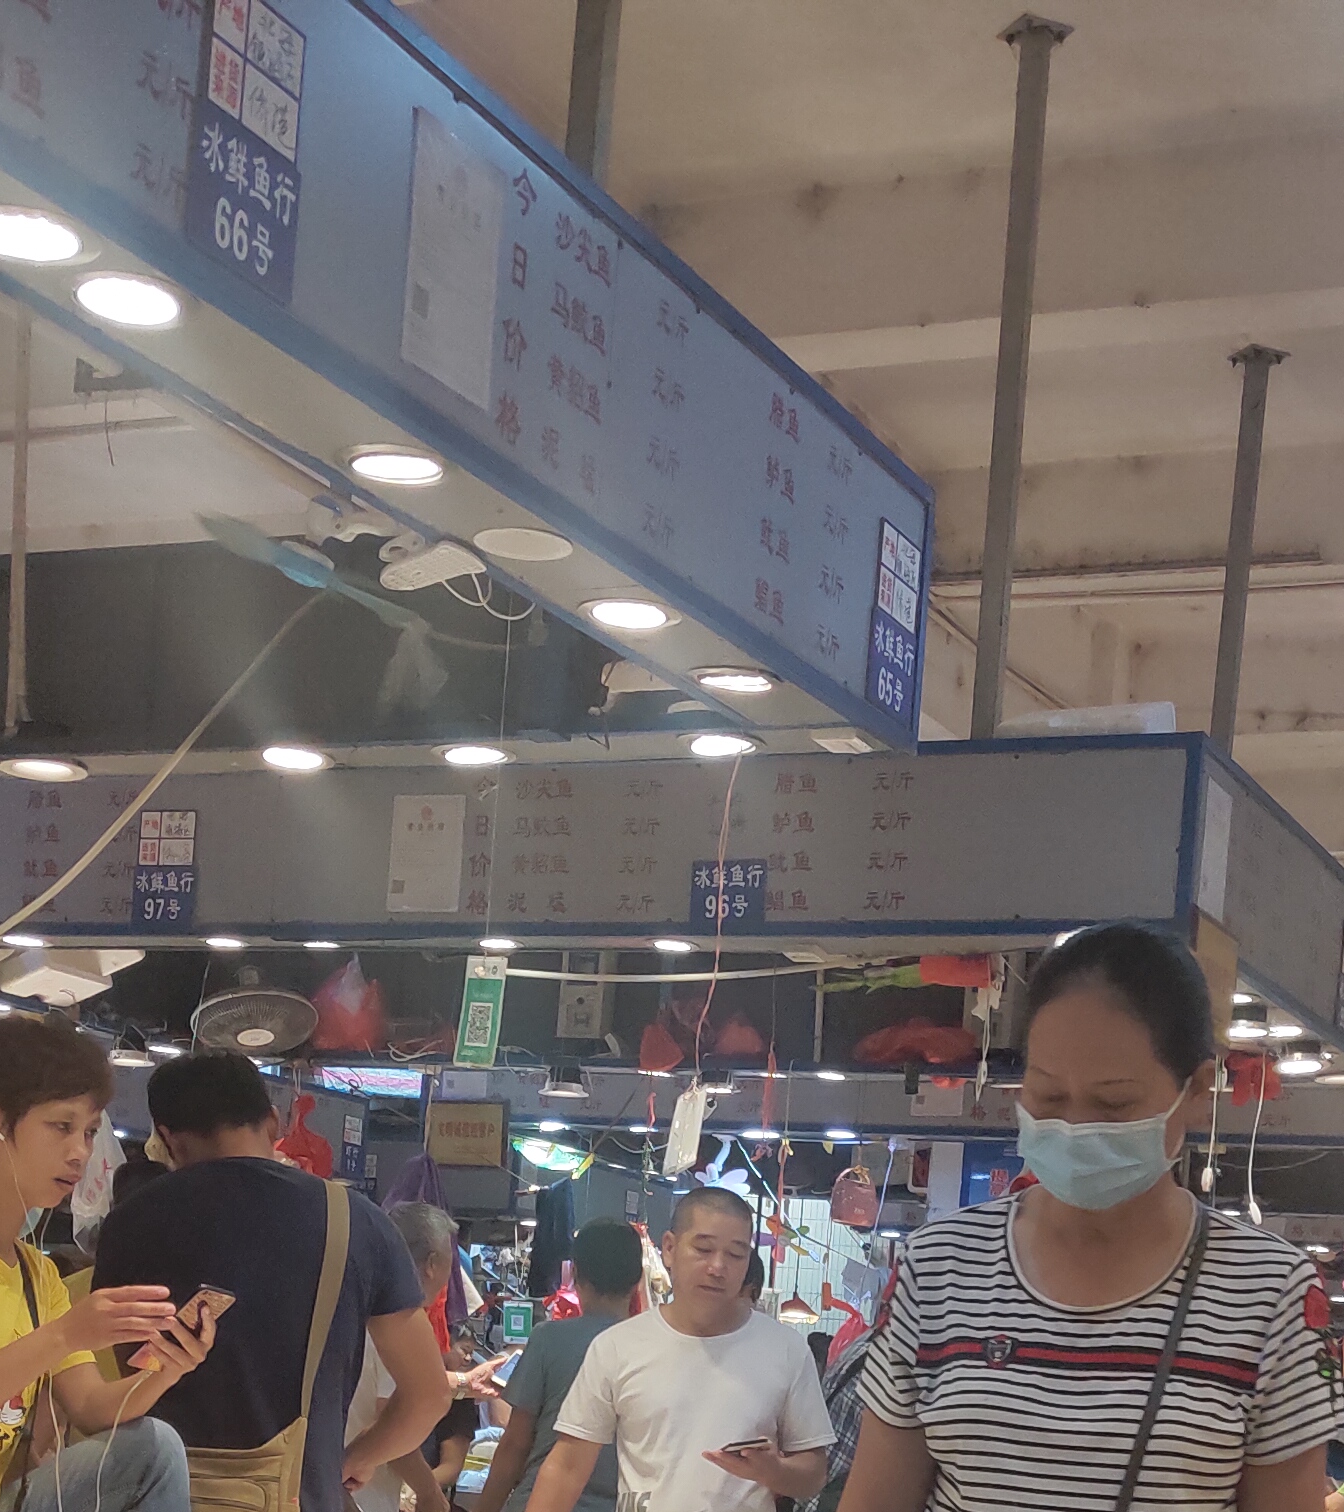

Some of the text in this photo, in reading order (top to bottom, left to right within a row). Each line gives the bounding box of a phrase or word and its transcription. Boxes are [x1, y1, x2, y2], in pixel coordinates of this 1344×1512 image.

[201, 122, 296, 226] 冰鲜鱼行
[215, 197, 274, 276] 66号
[495, 167, 539, 446] 今日价格
[874, 620, 915, 678] 冰鲜鱼行
[877, 666, 904, 713] 65号
[515, 778, 575, 800] 沙尖鱼
[872, 770, 915, 792] 元/斤
[869, 811, 912, 832] 元/斤
[466, 775, 498, 916] 今日价格
[866, 851, 909, 872] 元/斤
[135, 871, 195, 894] 冰鲜鱼行
[694, 864, 764, 889] 冰鲜鱼行
[143, 898, 182, 921] 97号
[704, 895, 749, 919] 96号
[863, 890, 906, 912] 元/斤
